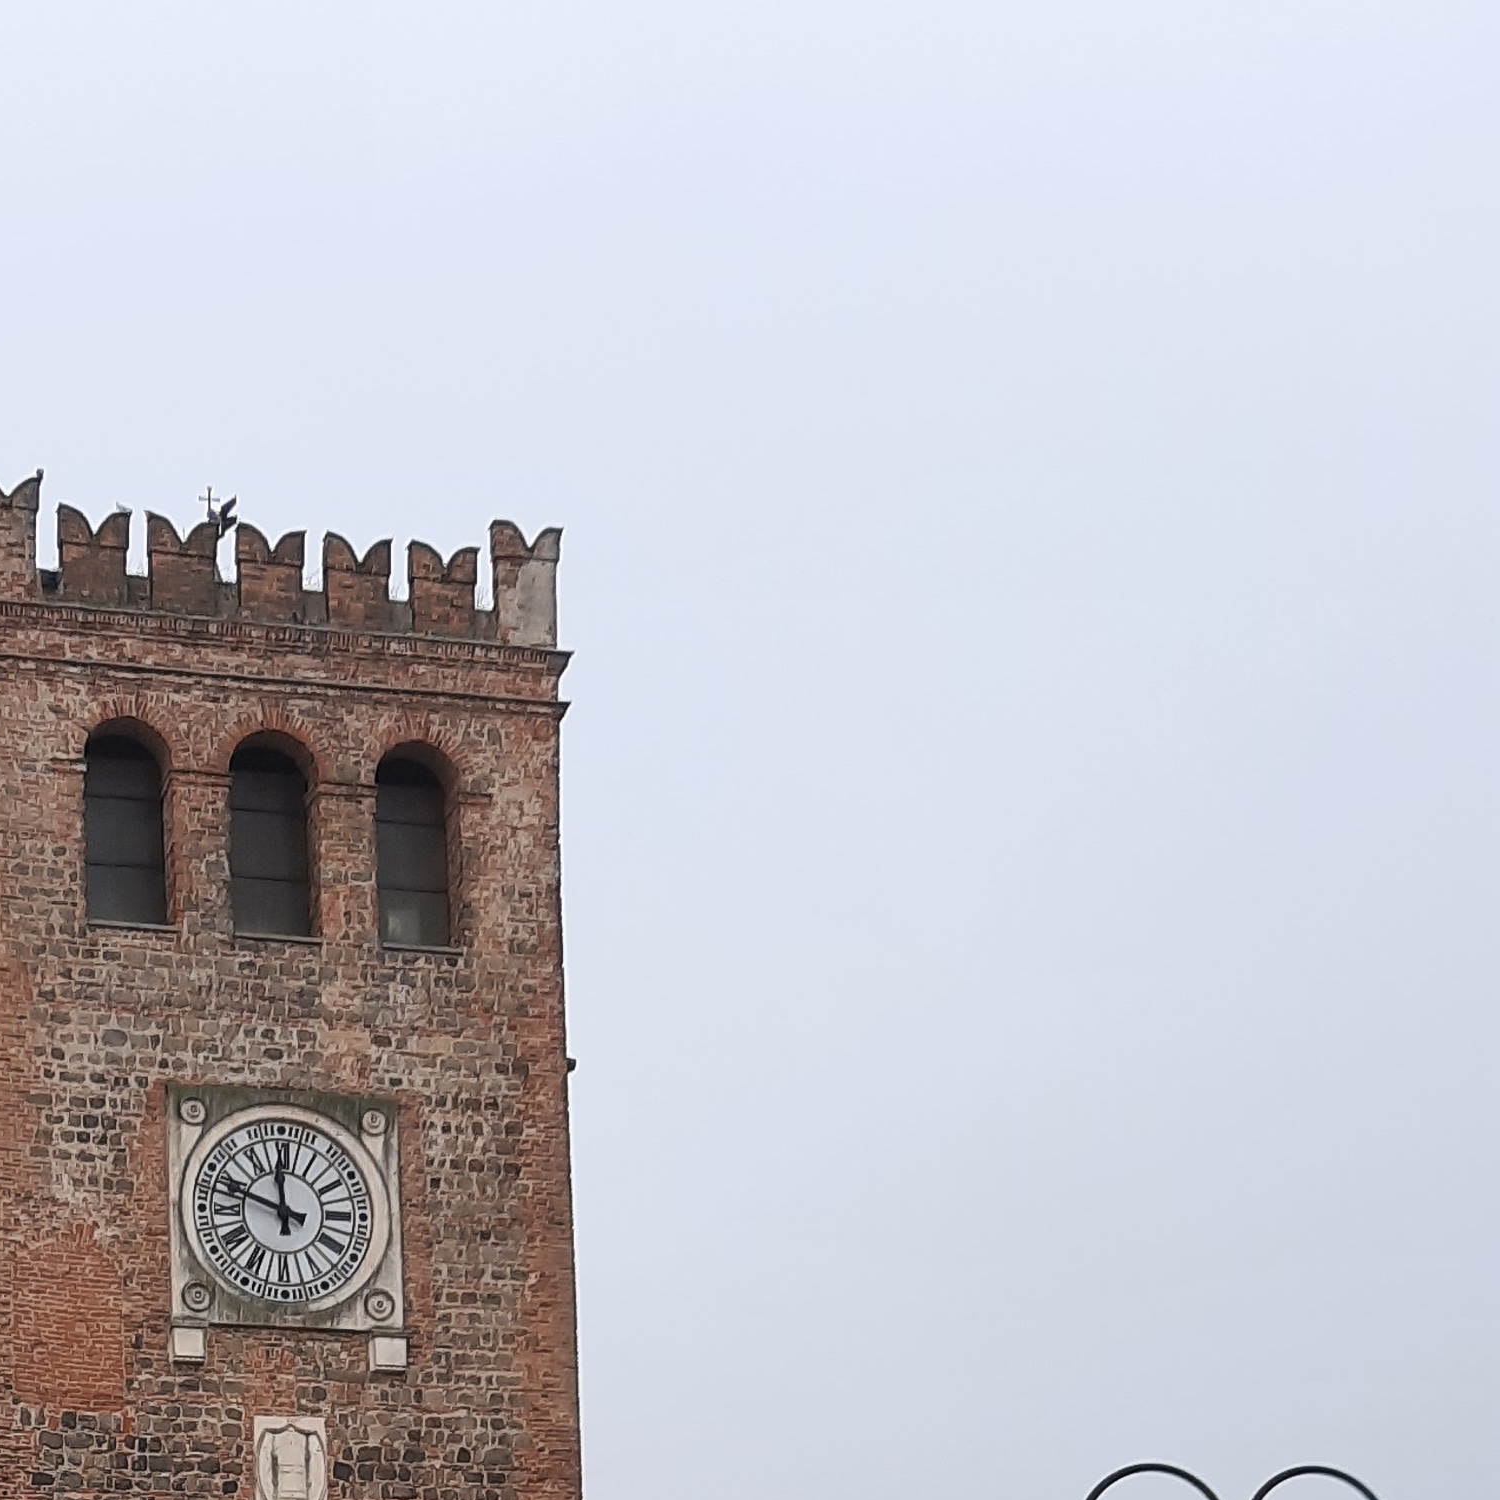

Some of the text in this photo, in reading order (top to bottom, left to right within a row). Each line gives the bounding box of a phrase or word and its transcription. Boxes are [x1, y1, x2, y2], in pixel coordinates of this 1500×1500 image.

[243, 1147, 267, 1176] XI
[303, 1153, 317, 1177] I
[318, 1179, 343, 1197] II
[214, 1202, 241, 1216] IX
[325, 1211, 351, 1222] III
[278, 1255, 290, 1282] VI
[304, 1250, 323, 1277] V
